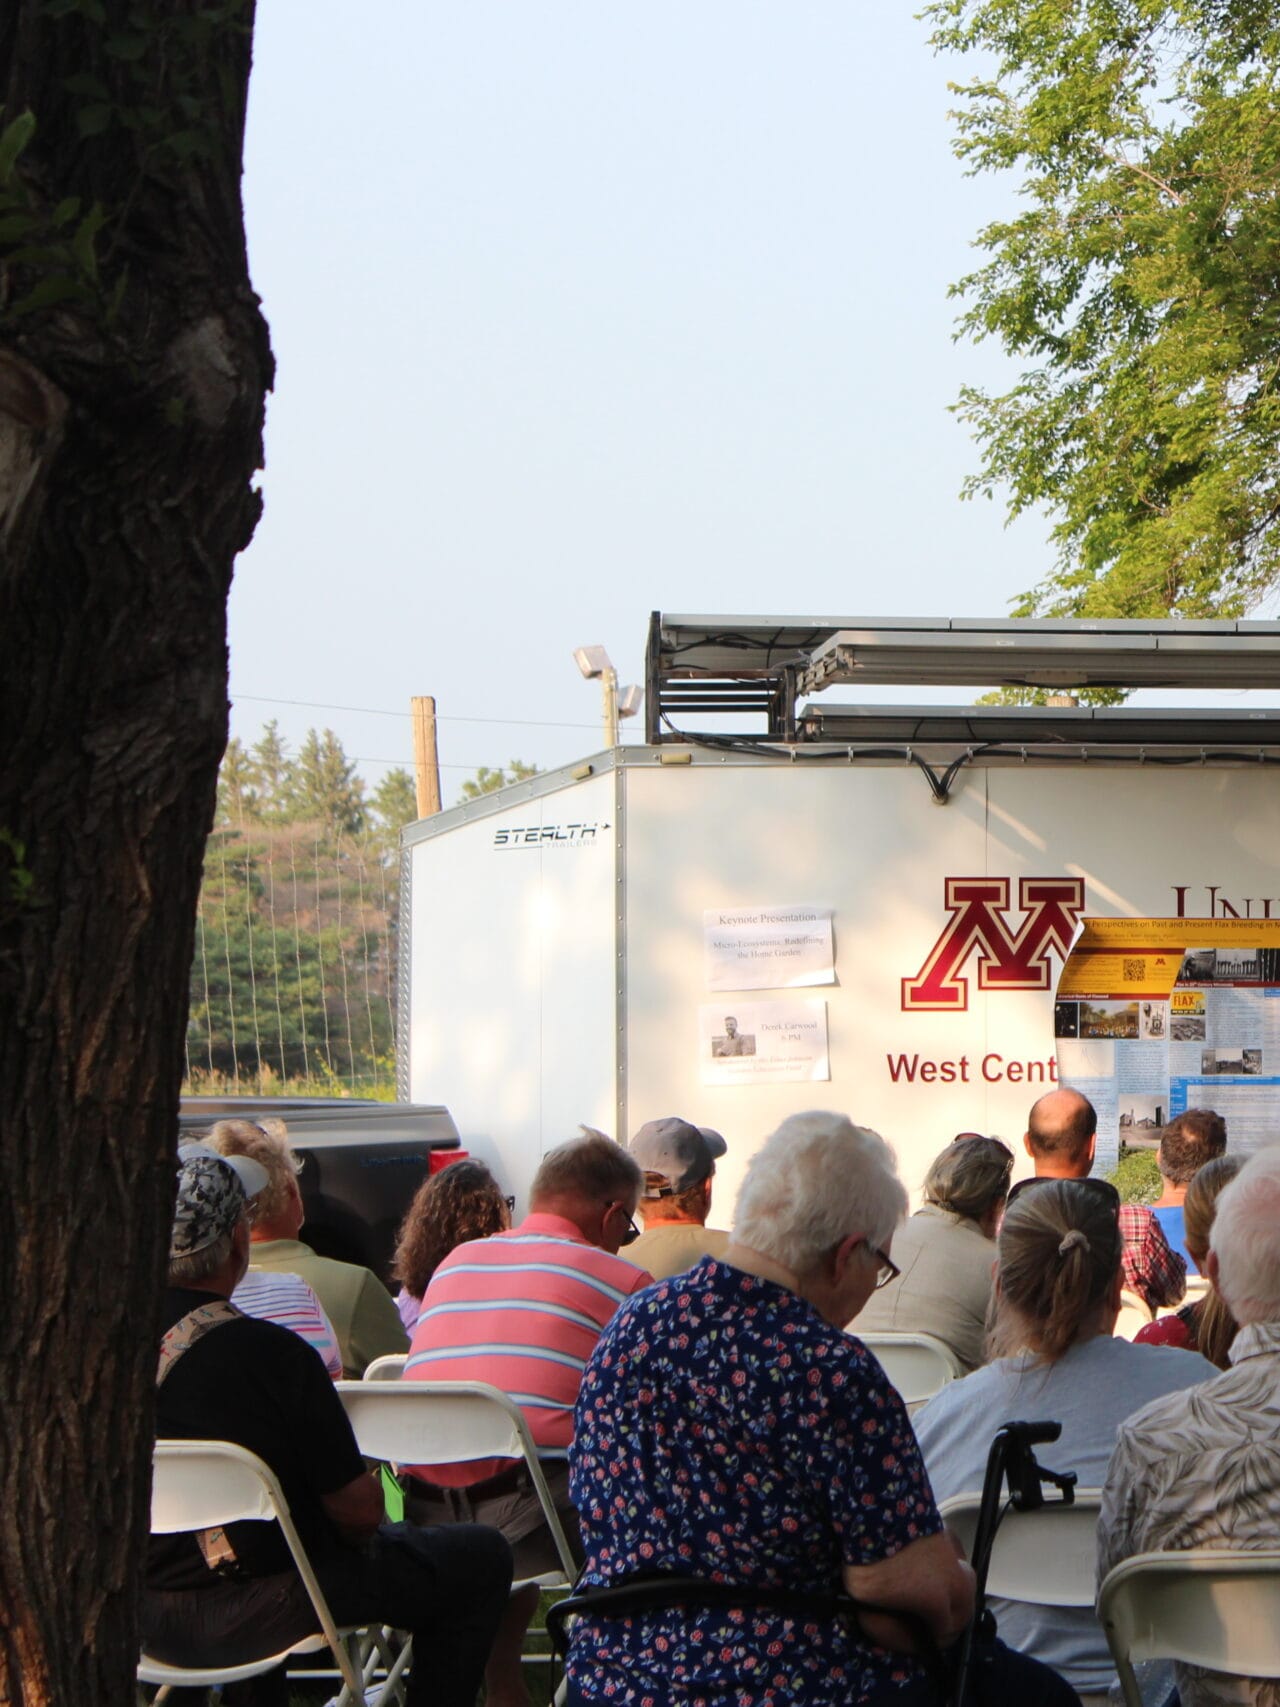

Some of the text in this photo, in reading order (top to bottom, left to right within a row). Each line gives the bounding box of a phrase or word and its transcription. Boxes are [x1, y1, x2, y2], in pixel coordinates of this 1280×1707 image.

[494, 823, 598, 844] STEALTH
[719, 912, 817, 926] Keynote Presentation
[1093, 920, 1139, 929] Perspectives
[1152, 920, 1167, 928] Past
[1169, 920, 1183, 928] and
[1186, 920, 1212, 928] Present
[1215, 920, 1229, 929] Flax
[1232, 921, 1264, 930] Breeding
[737, 949, 802, 959] the Home Garden
[1173, 995, 1196, 1007] FLAX
[761, 1022, 783, 1032] Derek
[886, 1053, 1059, 1083] West Cent
